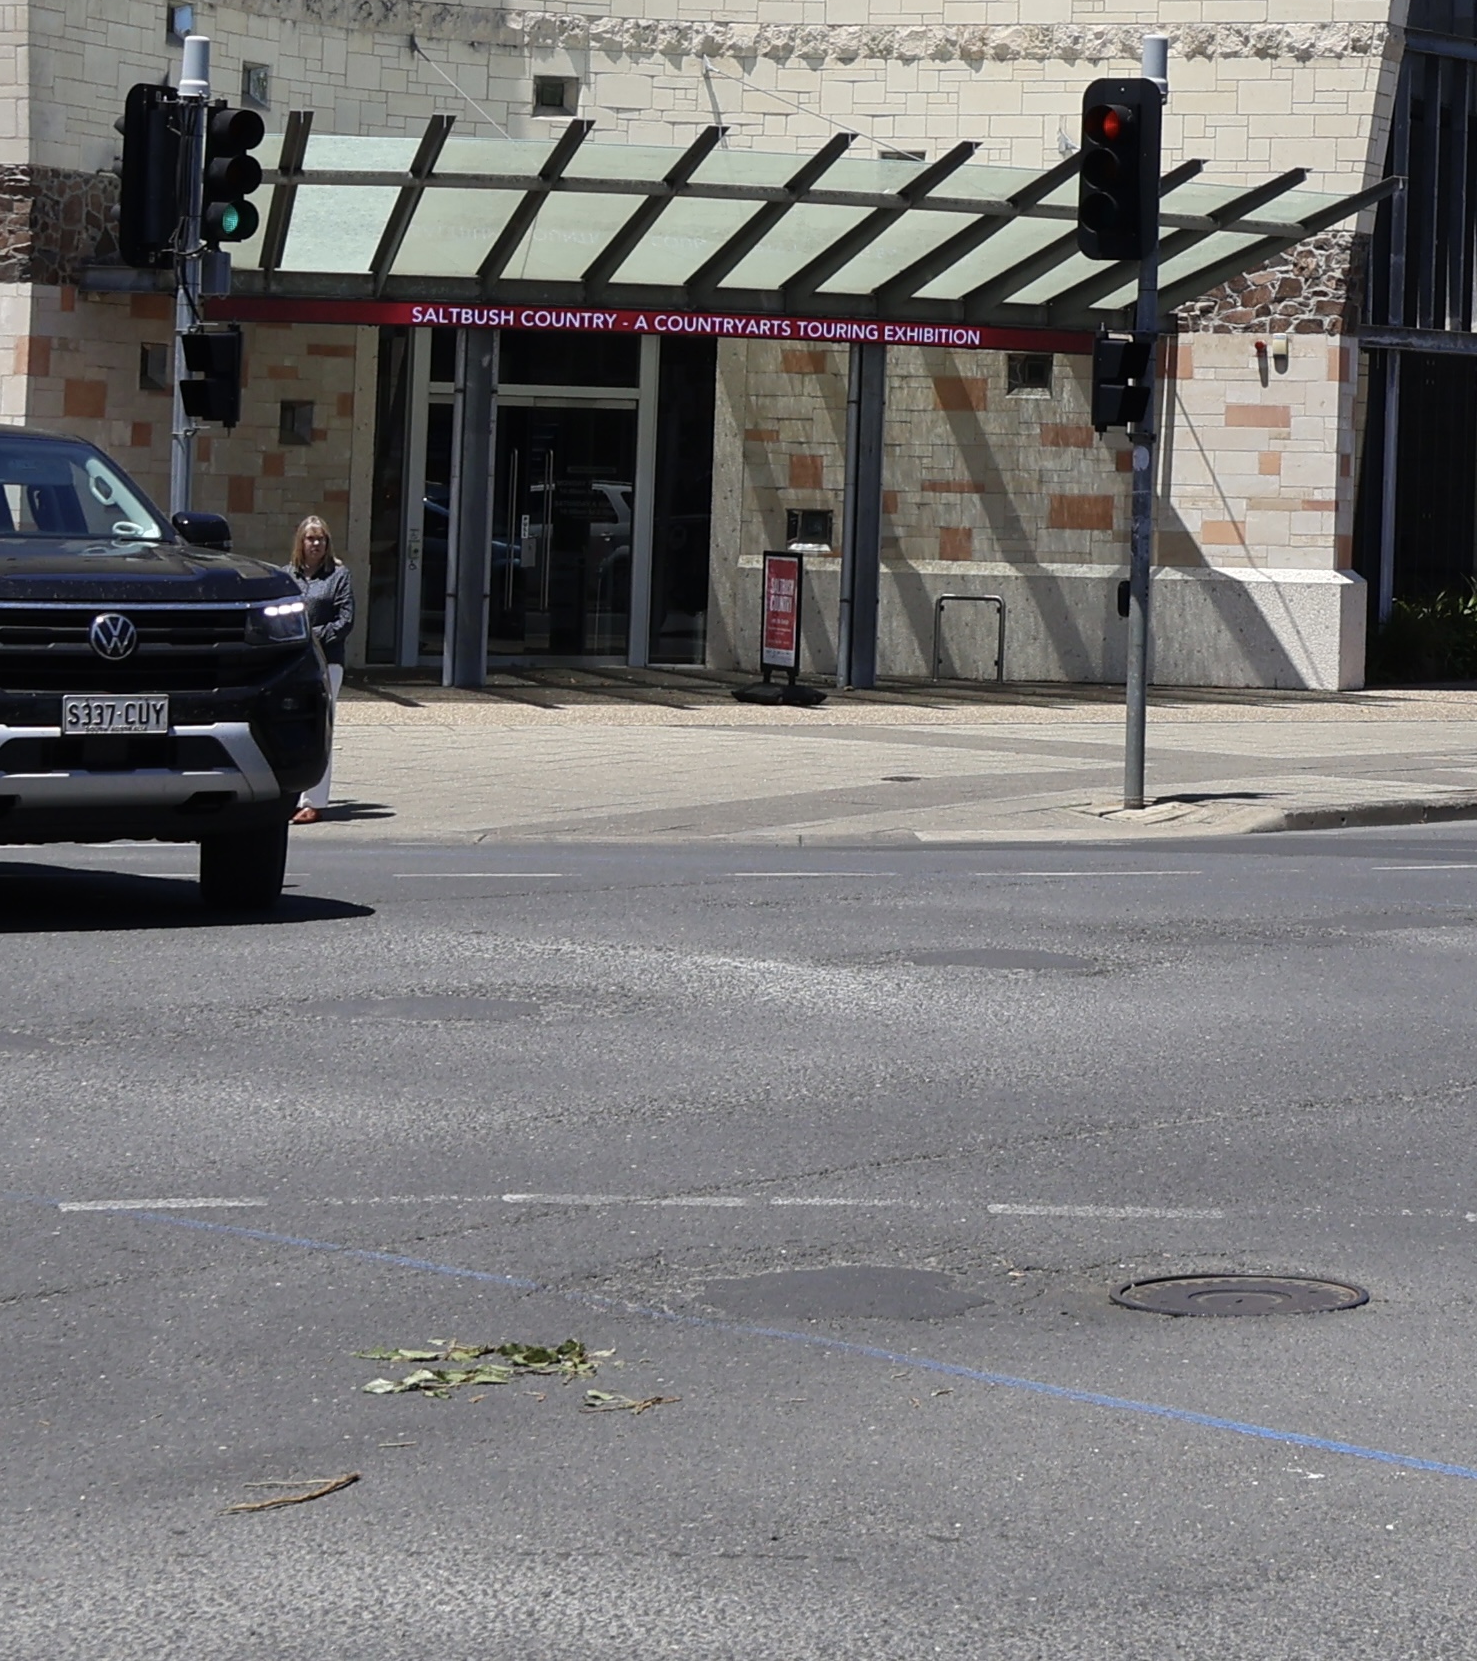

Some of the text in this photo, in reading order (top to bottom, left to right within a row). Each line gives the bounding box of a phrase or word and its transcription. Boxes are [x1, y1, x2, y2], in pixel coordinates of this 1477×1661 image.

[411, 306, 514, 327] SALTBUSH
[520, 310, 617, 329] COUNTRY
[633, 314, 649, 330] A
[654, 314, 792, 337] COUNTRYARTS
[798, 321, 879, 340] TOURING
[884, 324, 981, 346] EXHIBITION
